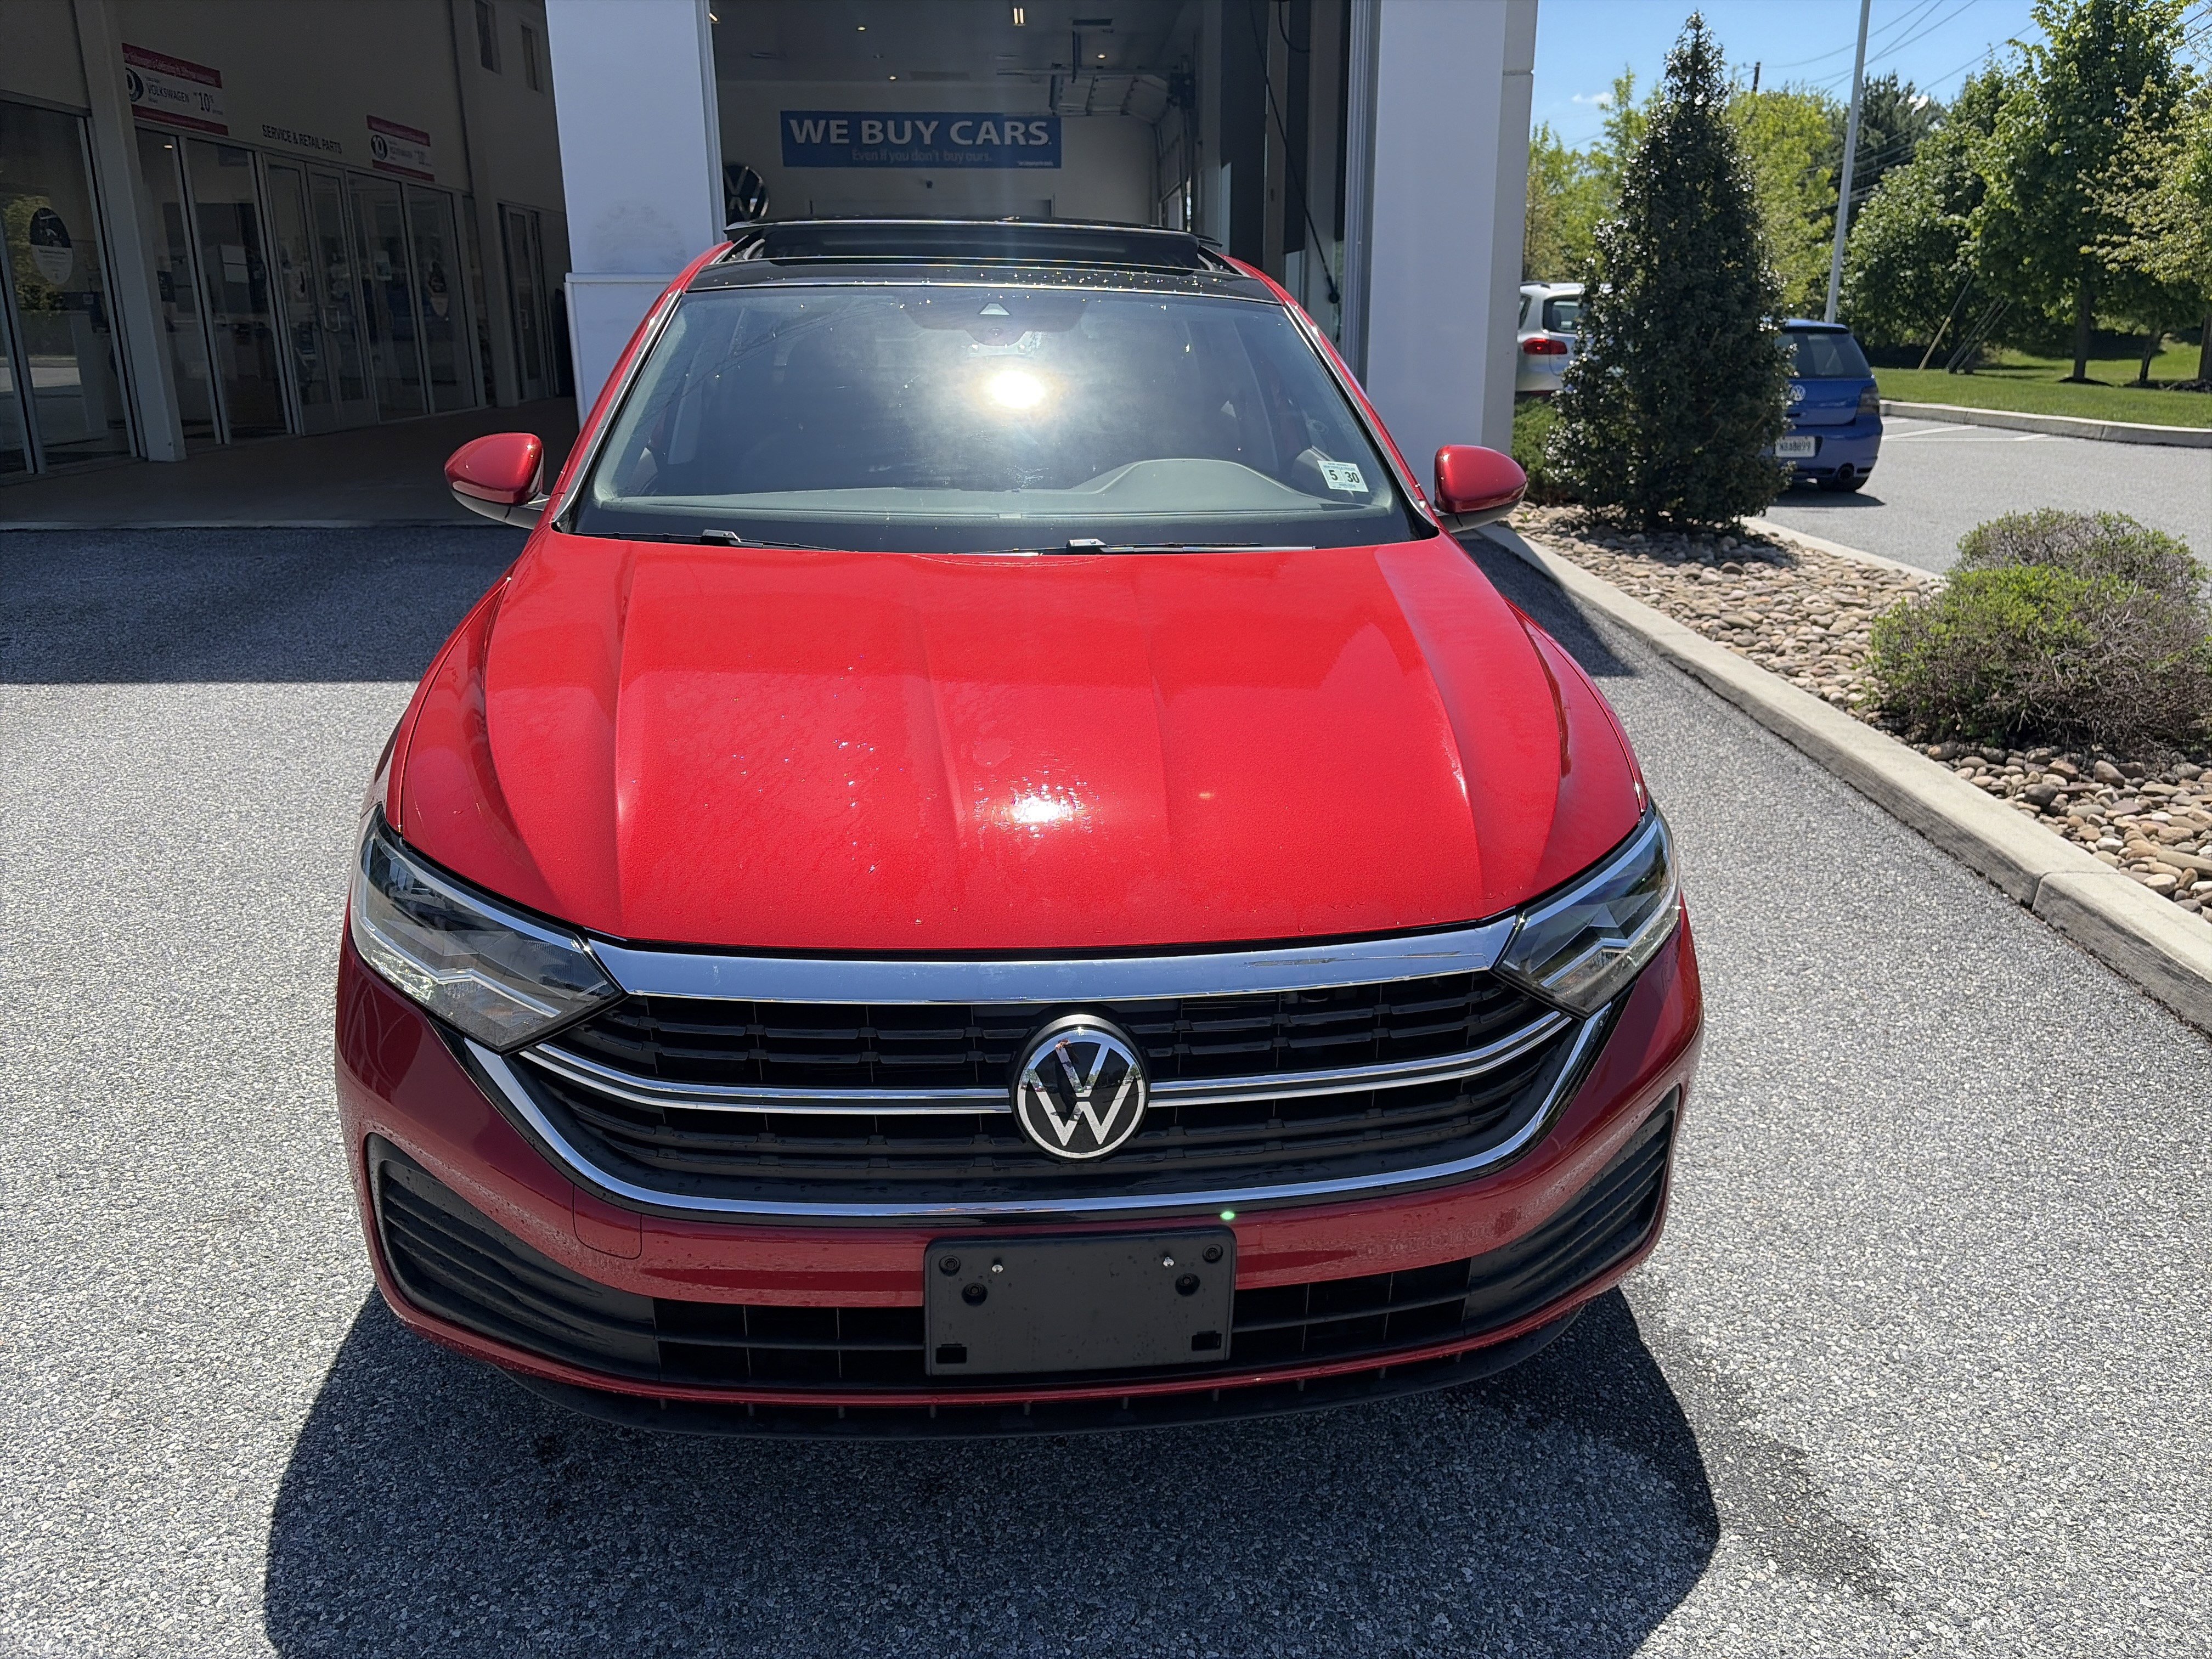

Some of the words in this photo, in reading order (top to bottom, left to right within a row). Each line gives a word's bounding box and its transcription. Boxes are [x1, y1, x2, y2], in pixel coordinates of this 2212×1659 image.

[146, 83, 190, 103] VOLKSWAGEN
[262, 125, 292, 143] SERVICE
[293, 132, 298, 144] &
[299, 133, 321, 150] RETAIL
[321, 138, 342, 154] PARTS
[789, 120, 850, 144] WE
[861, 120, 939, 145] BUY
[950, 121, 1052, 145] CARS.
[851, 149, 878, 161] Even
[888, 152, 909, 163] you
[911, 149, 939, 161] don't
[943, 150, 964, 164] buy
[966, 153, 992, 161] ours.
[1328, 470, 1338, 481] 5
[1345, 471, 1360, 483] 30
[1020, 1034, 1142, 1151] VW
